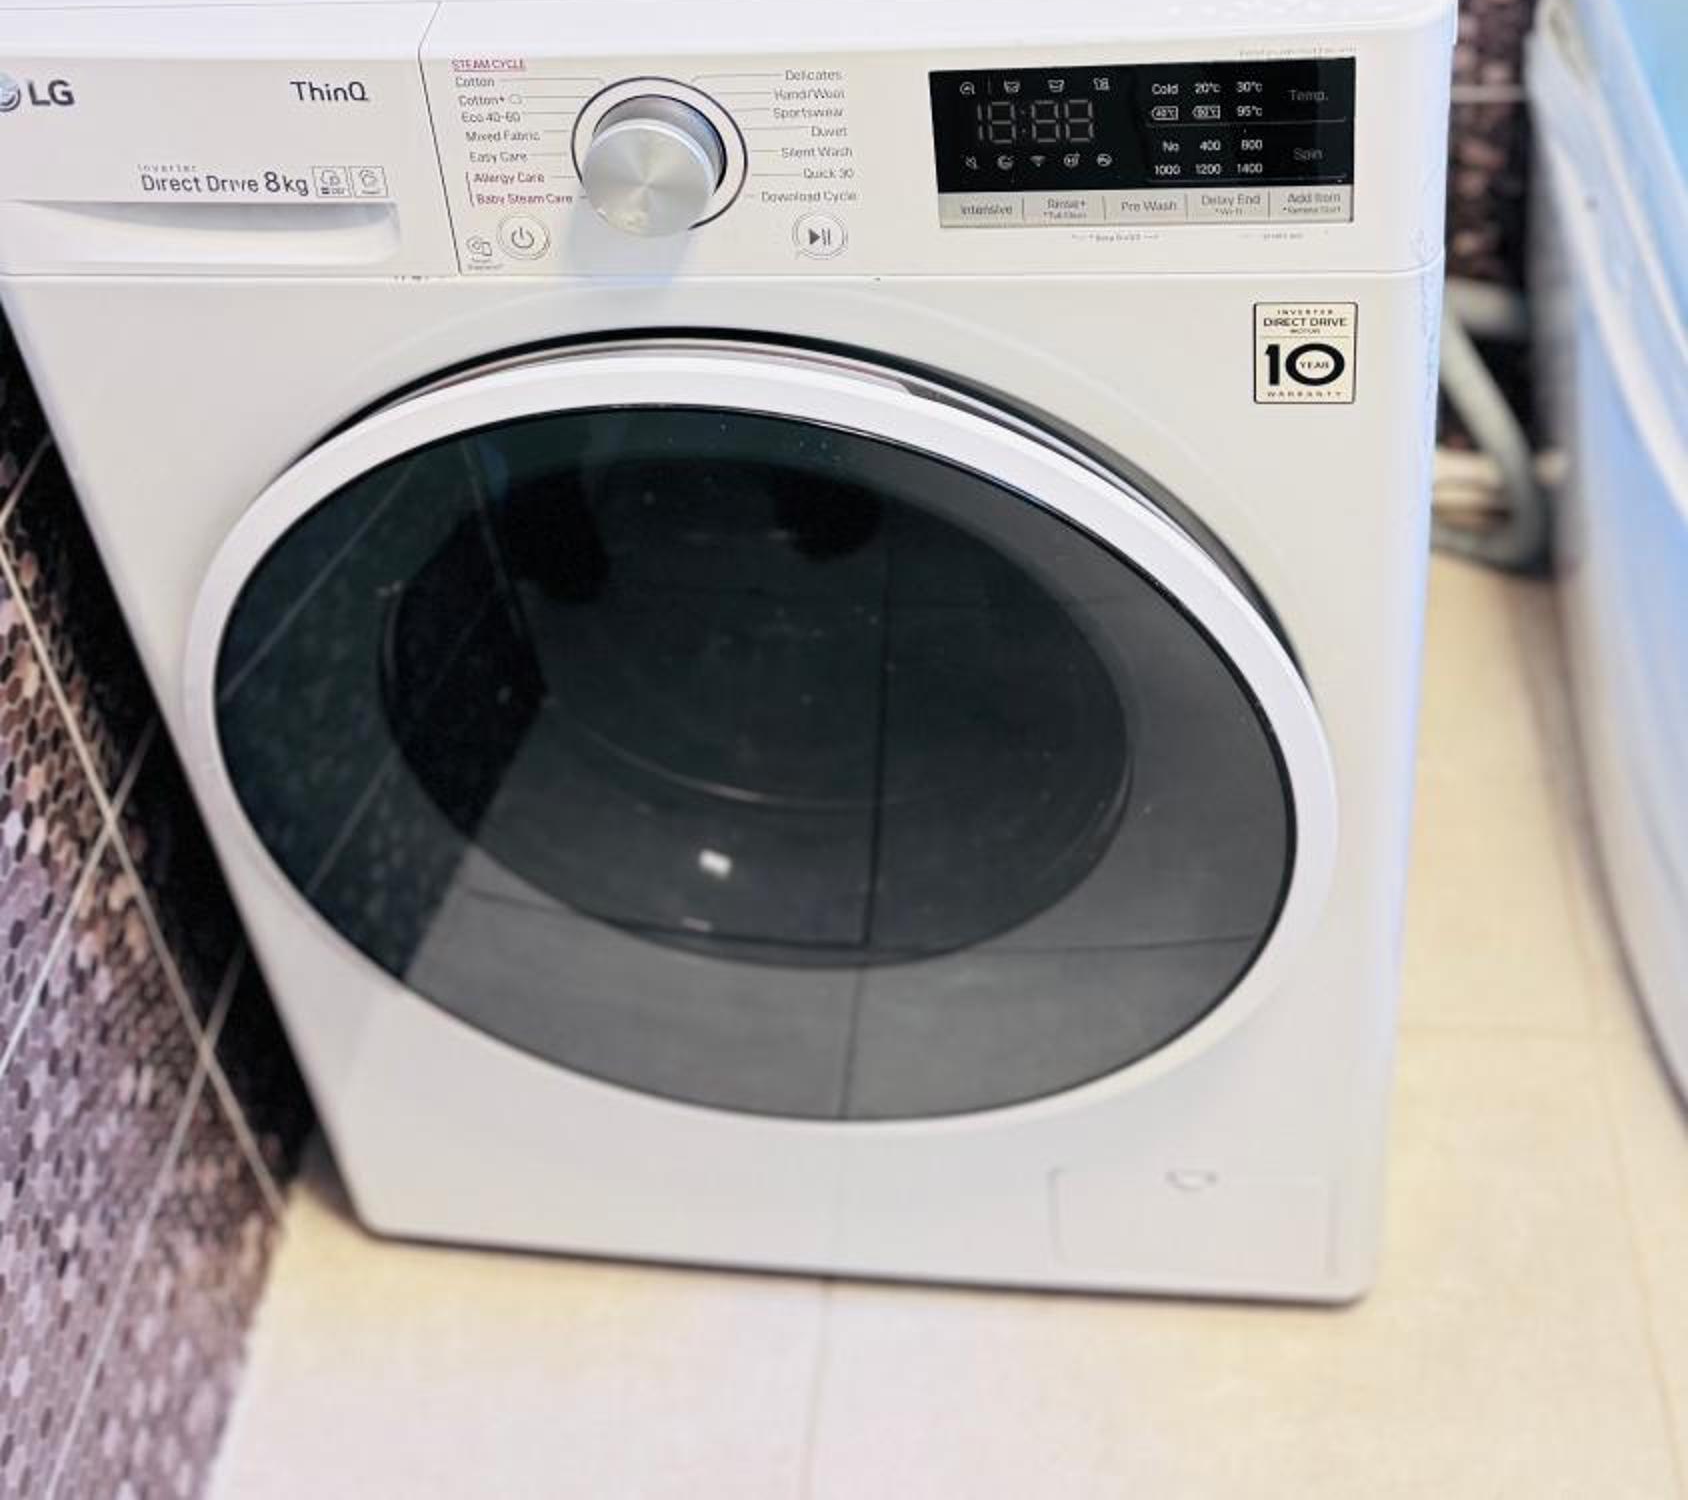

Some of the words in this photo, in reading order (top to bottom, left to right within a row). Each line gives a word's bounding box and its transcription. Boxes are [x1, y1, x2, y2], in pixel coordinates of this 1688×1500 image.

[452, 59, 491, 70] STEAM
[492, 59, 524, 70] CYCLE
[785, 69, 843, 81] Delicates
[455, 77, 495, 88] Cotton
[28, 79, 76, 107] LG
[290, 80, 371, 103] ThinQ
[1151, 83, 1179, 95] Cold
[461, 111, 484, 123] Eco
[485, 111, 521, 123] 40-60
[773, 107, 844, 120] Sportswear
[465, 131, 501, 142] Mixed
[503, 131, 541, 141] Fabric
[811, 125, 848, 137] Duvet
[1162, 141, 1180, 152] No
[1199, 140, 1221, 151] 400
[1241, 139, 1263, 150] 800
[469, 152, 497, 164] Easy
[499, 152, 528, 163] Care
[781, 147, 815, 158] Silent
[816, 146, 853, 157] Wash
[1293, 148, 1324, 162] Spin
[803, 168, 835, 179] Quick
[839, 168, 855, 179] 30
[1154, 164, 1181, 176] 1000
[1195, 163, 1222, 175] 1200
[1236, 163, 1263, 174] 1400
[141, 174, 202, 193] Direct
[206, 174, 259, 193] Drive
[473, 172, 515, 185] Allergy
[517, 171, 545, 183] Care
[476, 193, 505, 206] Baby
[507, 193, 545, 205] Steam
[545, 193, 573, 204] Care
[761, 190, 821, 203] Download
[823, 190, 857, 204] Cycle
[1200, 194, 1235, 207] Delay
[1236, 193, 1261, 205] End
[1287, 192, 1312, 203] Add
[1313, 191, 1341, 203] Item
[960, 203, 1013, 216] Intensive
[1120, 202, 1141, 213] Pre
[1143, 200, 1177, 212] Wash
[1263, 317, 1306, 327] DIRECT
[1309, 317, 1348, 327] DRIVE
[1264, 343, 1346, 387] 10
[1299, 361, 1330, 370] YEAR
[1267, 390, 1342, 398] WARRANTY
